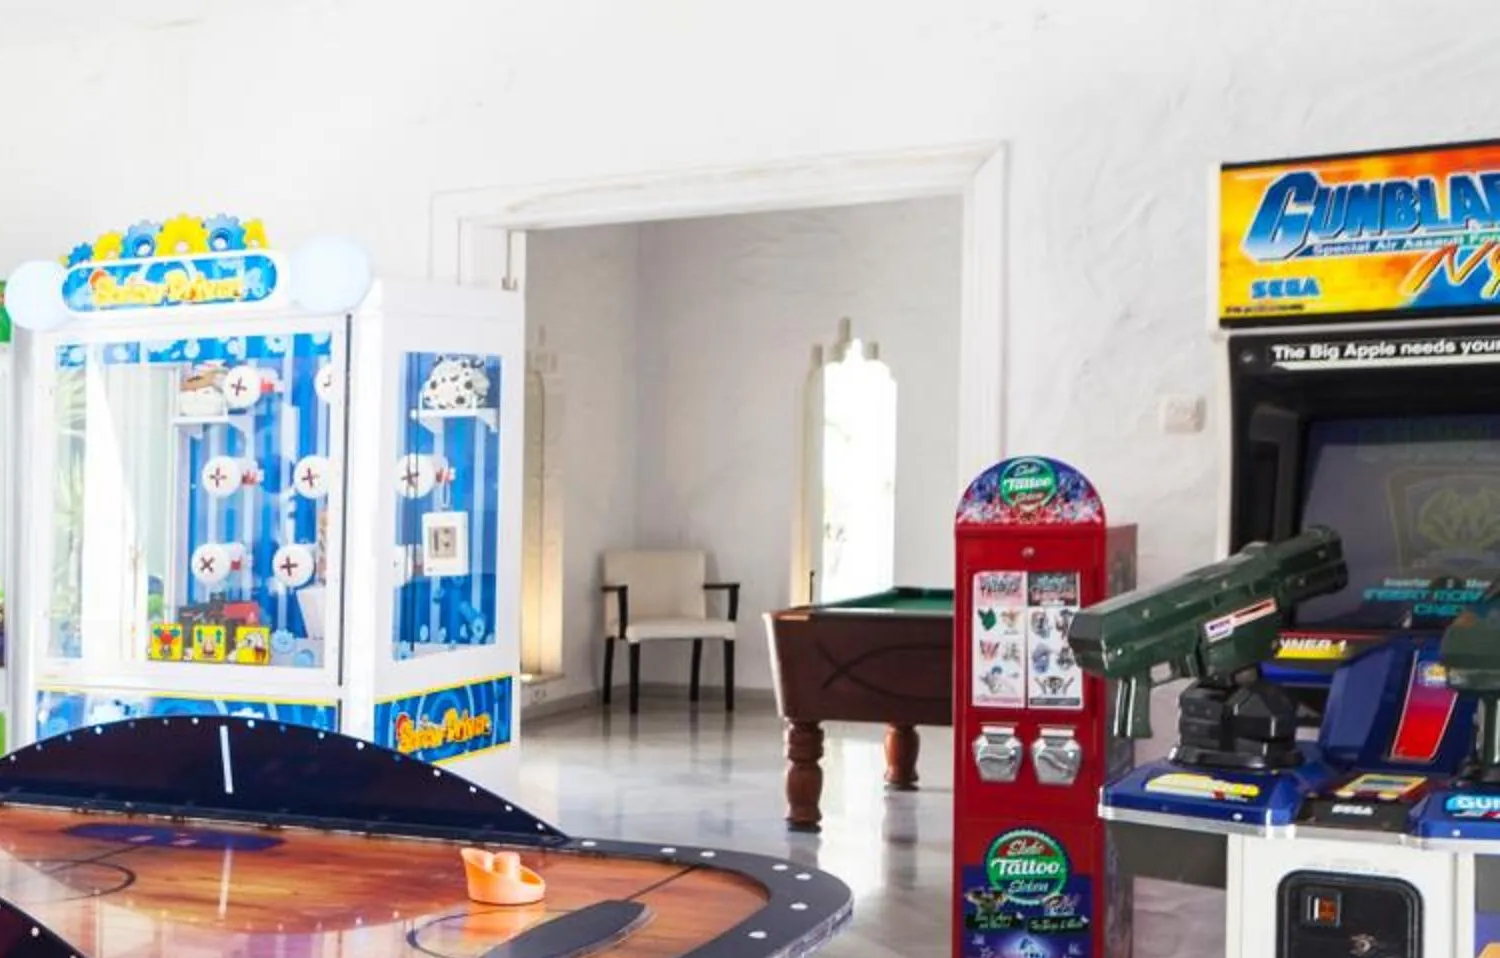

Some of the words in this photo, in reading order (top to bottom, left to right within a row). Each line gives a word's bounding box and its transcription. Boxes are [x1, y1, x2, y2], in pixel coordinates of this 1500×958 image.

[1250, 279, 1318, 298] SEGA
[1271, 345, 1305, 360] The
[1309, 344, 1339, 360] Big
[1343, 341, 1396, 361] Apple
[1400, 338, 1455, 355] needs
[1332, 803, 1374, 816] SEGA
[990, 857, 1060, 877] Tattoo
